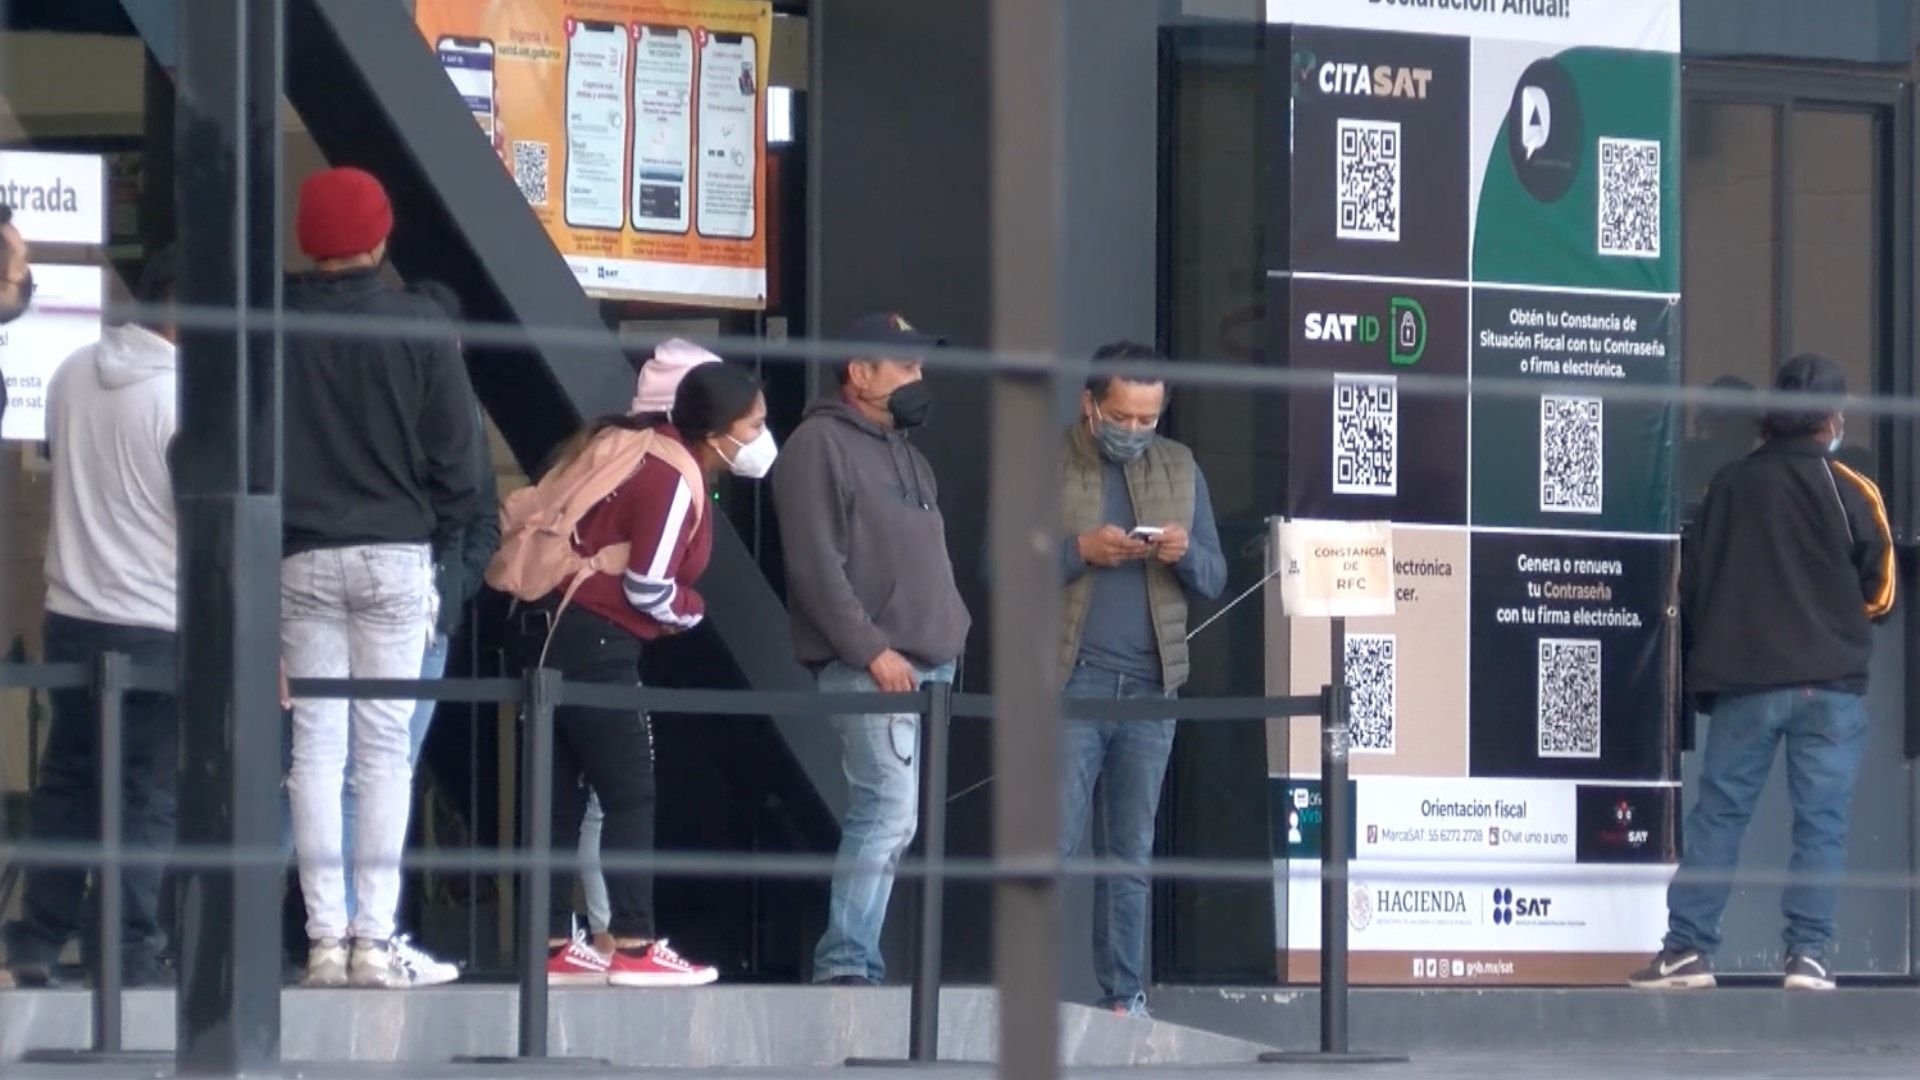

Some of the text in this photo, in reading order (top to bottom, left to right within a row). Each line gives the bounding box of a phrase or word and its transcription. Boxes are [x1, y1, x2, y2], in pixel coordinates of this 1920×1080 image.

[1369, 0, 1570, 18] aración Anual!
[1319, 61, 1432, 99] CITASAT
[0, 177, 77, 212] ntrada
[1509, 308, 1637, 332] Obtén tu Constancia de
[1480, 328, 1665, 357] Situación Fiscal con tu Contraseña
[1520, 355, 1626, 378] o firma electrónica.
[1314, 547, 1387, 558] CONSTANCIA
[1343, 562, 1359, 571] DE
[1393, 556, 1452, 576] lectrónica
[1517, 554, 1622, 576] Genera o renueva
[1336, 577, 1367, 590] RFC
[1528, 581, 1612, 600] tu Contraseña
[1395, 586, 1418, 602] cer.
[1497, 604, 1642, 627] con tu firma electrónica.
[1421, 798, 1527, 819] Orientación fiscal
[1428, 829, 1439, 842] 55
[1502, 829, 1568, 845] Chat uno a uno
[1377, 890, 1466, 912] HACIENDA
[1516, 897, 1551, 916] SAT
